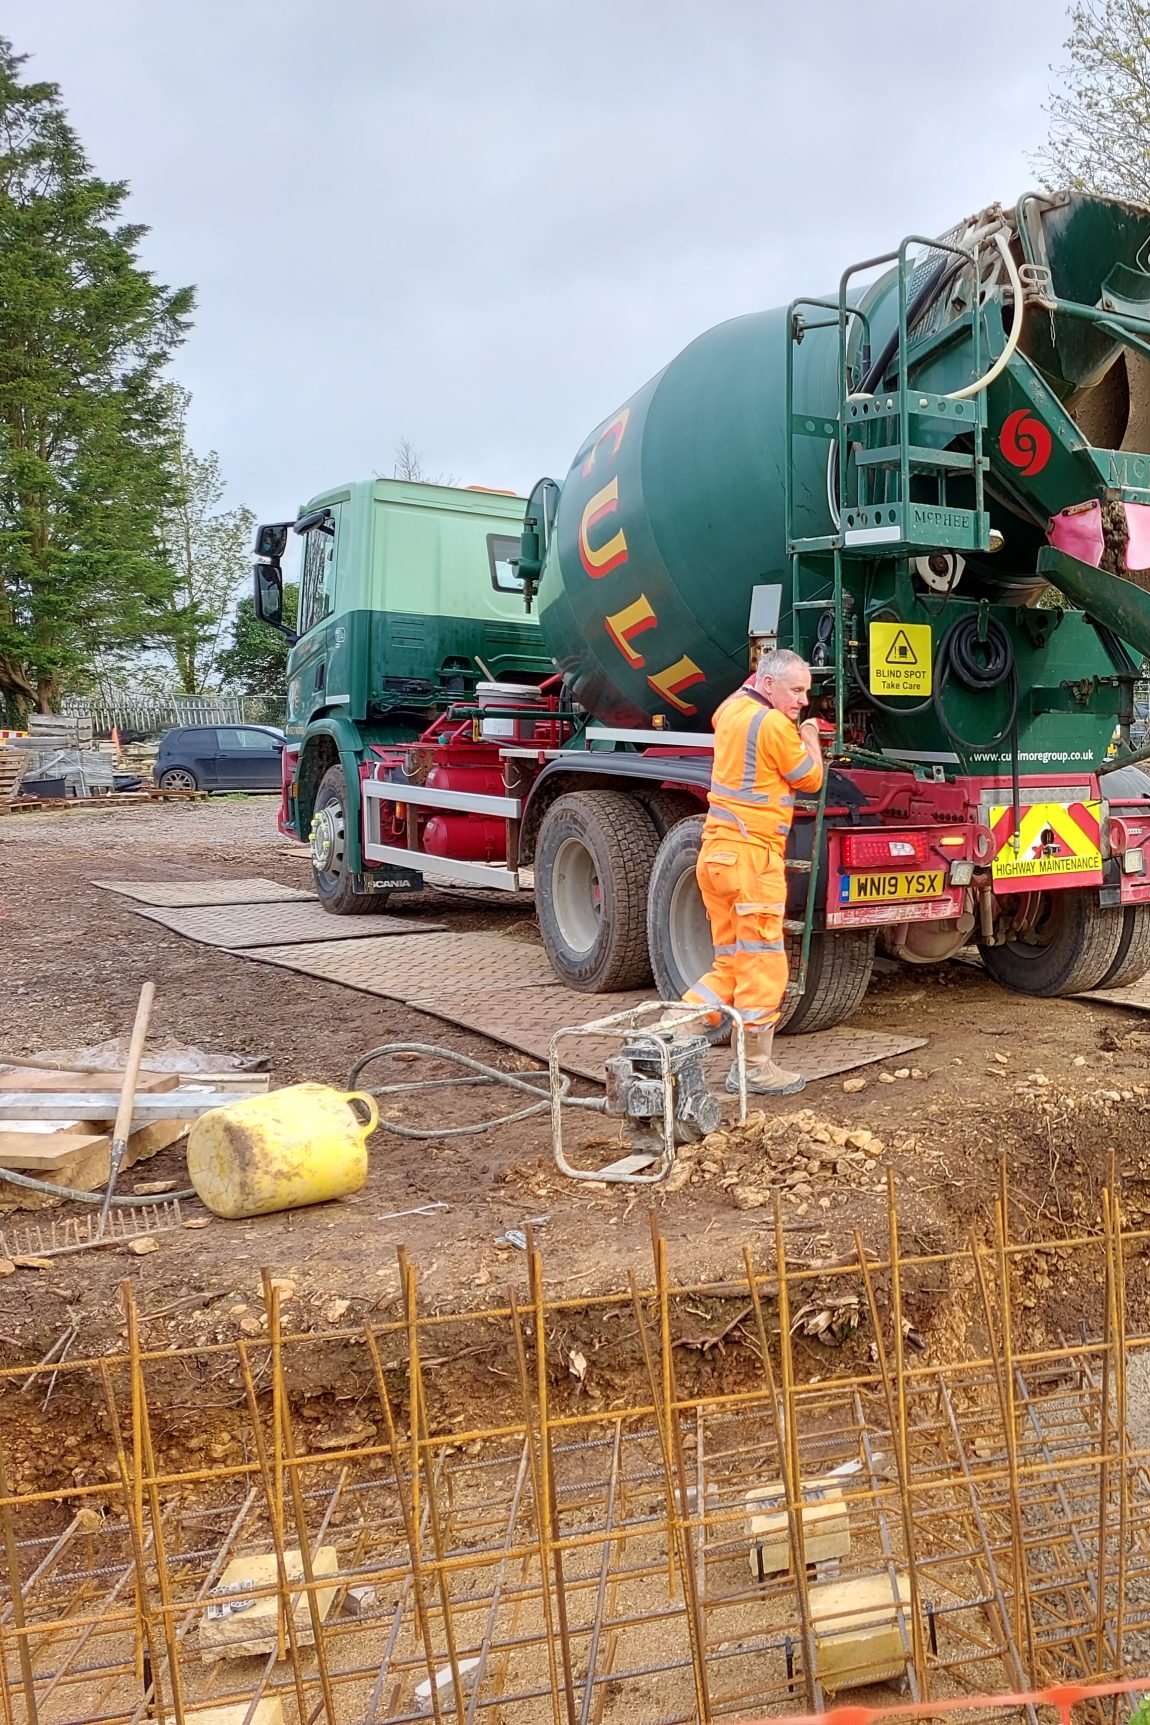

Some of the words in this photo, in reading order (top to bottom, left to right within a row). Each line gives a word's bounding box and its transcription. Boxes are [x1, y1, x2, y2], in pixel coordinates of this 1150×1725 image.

[876, 669, 902, 678] BLIND
[904, 670, 926, 679] SPOT
[881, 680, 900, 690] Take
[902, 681, 921, 690] Care
[973, 749, 1094, 763] www.cuimoregroup.co.uk
[996, 861, 1036, 876] HIGHWAY
[1039, 855, 1100, 873] MAINTENANCE
[857, 876, 899, 897] WN19
[904, 874, 938, 894] YSX
